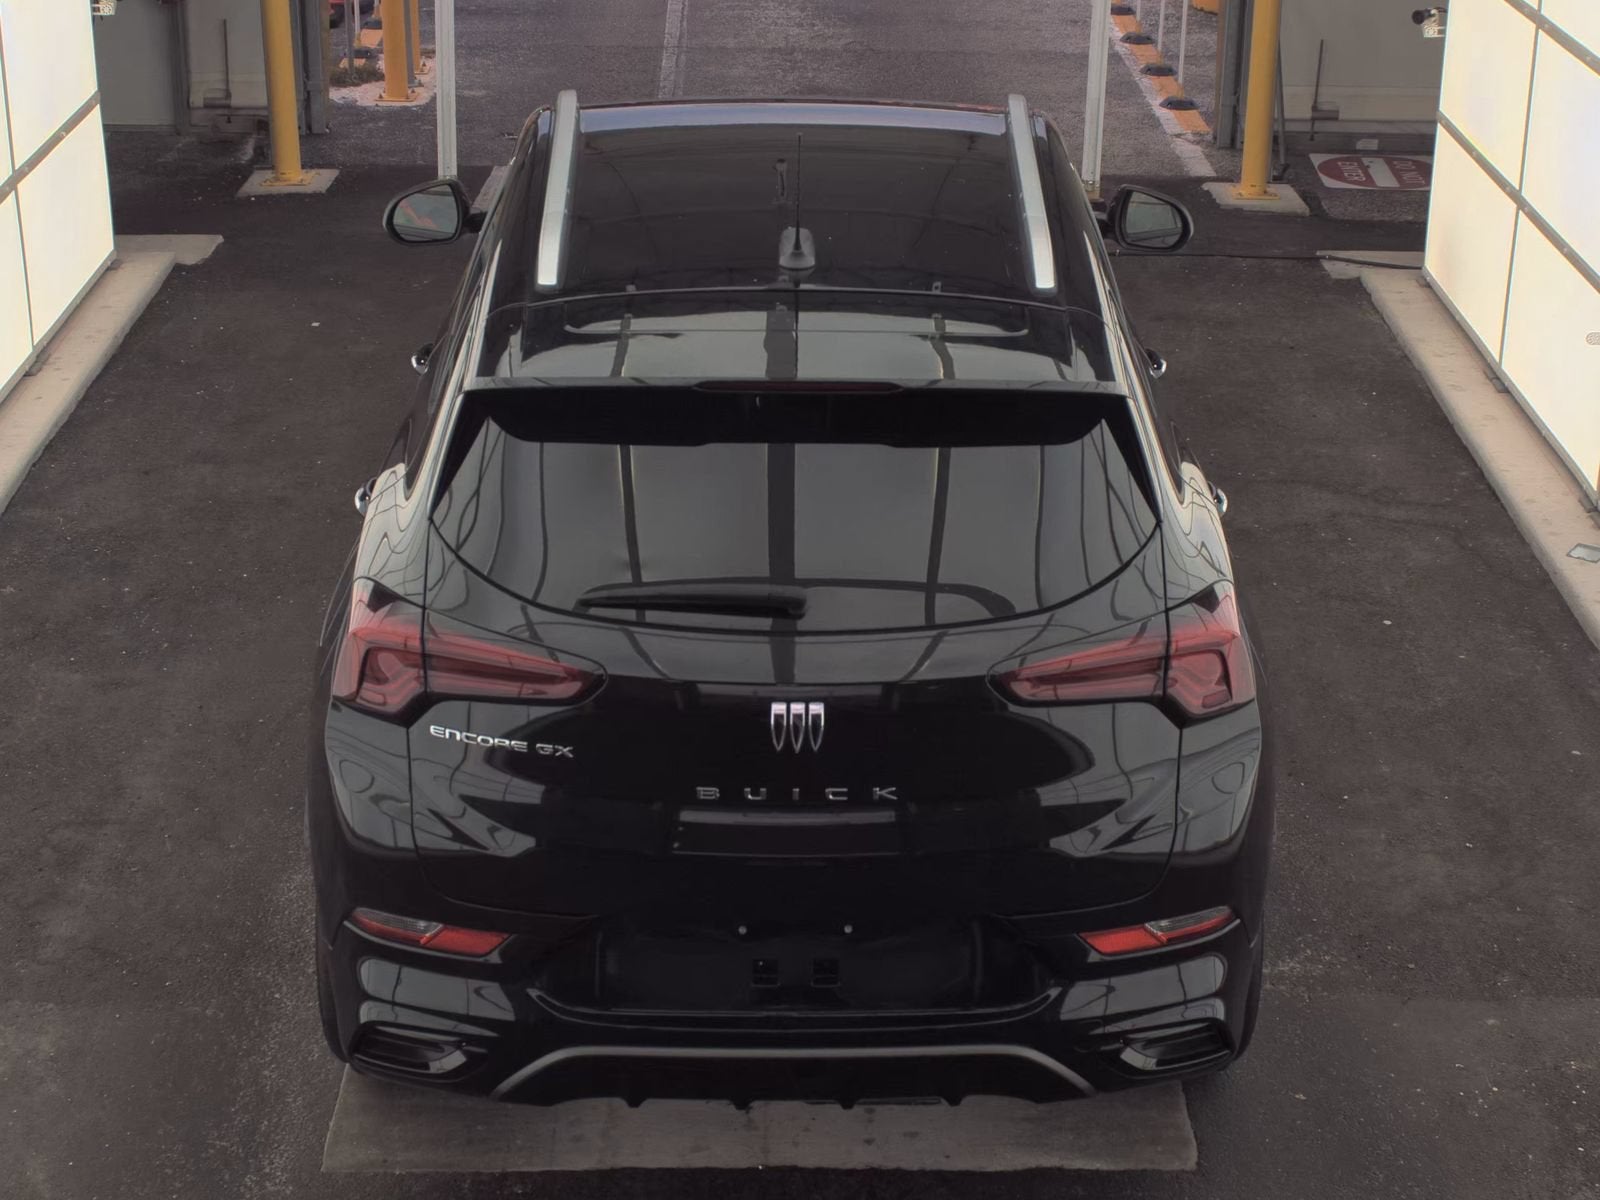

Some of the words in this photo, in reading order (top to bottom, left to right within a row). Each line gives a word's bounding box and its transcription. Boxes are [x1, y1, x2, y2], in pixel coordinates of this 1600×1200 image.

[1337, 161, 1366, 181] ENTER
[1399, 171, 1426, 185] NOT
[430, 724, 528, 752] ENCORE
[535, 743, 574, 758] GX
[696, 787, 898, 800] BUICK
